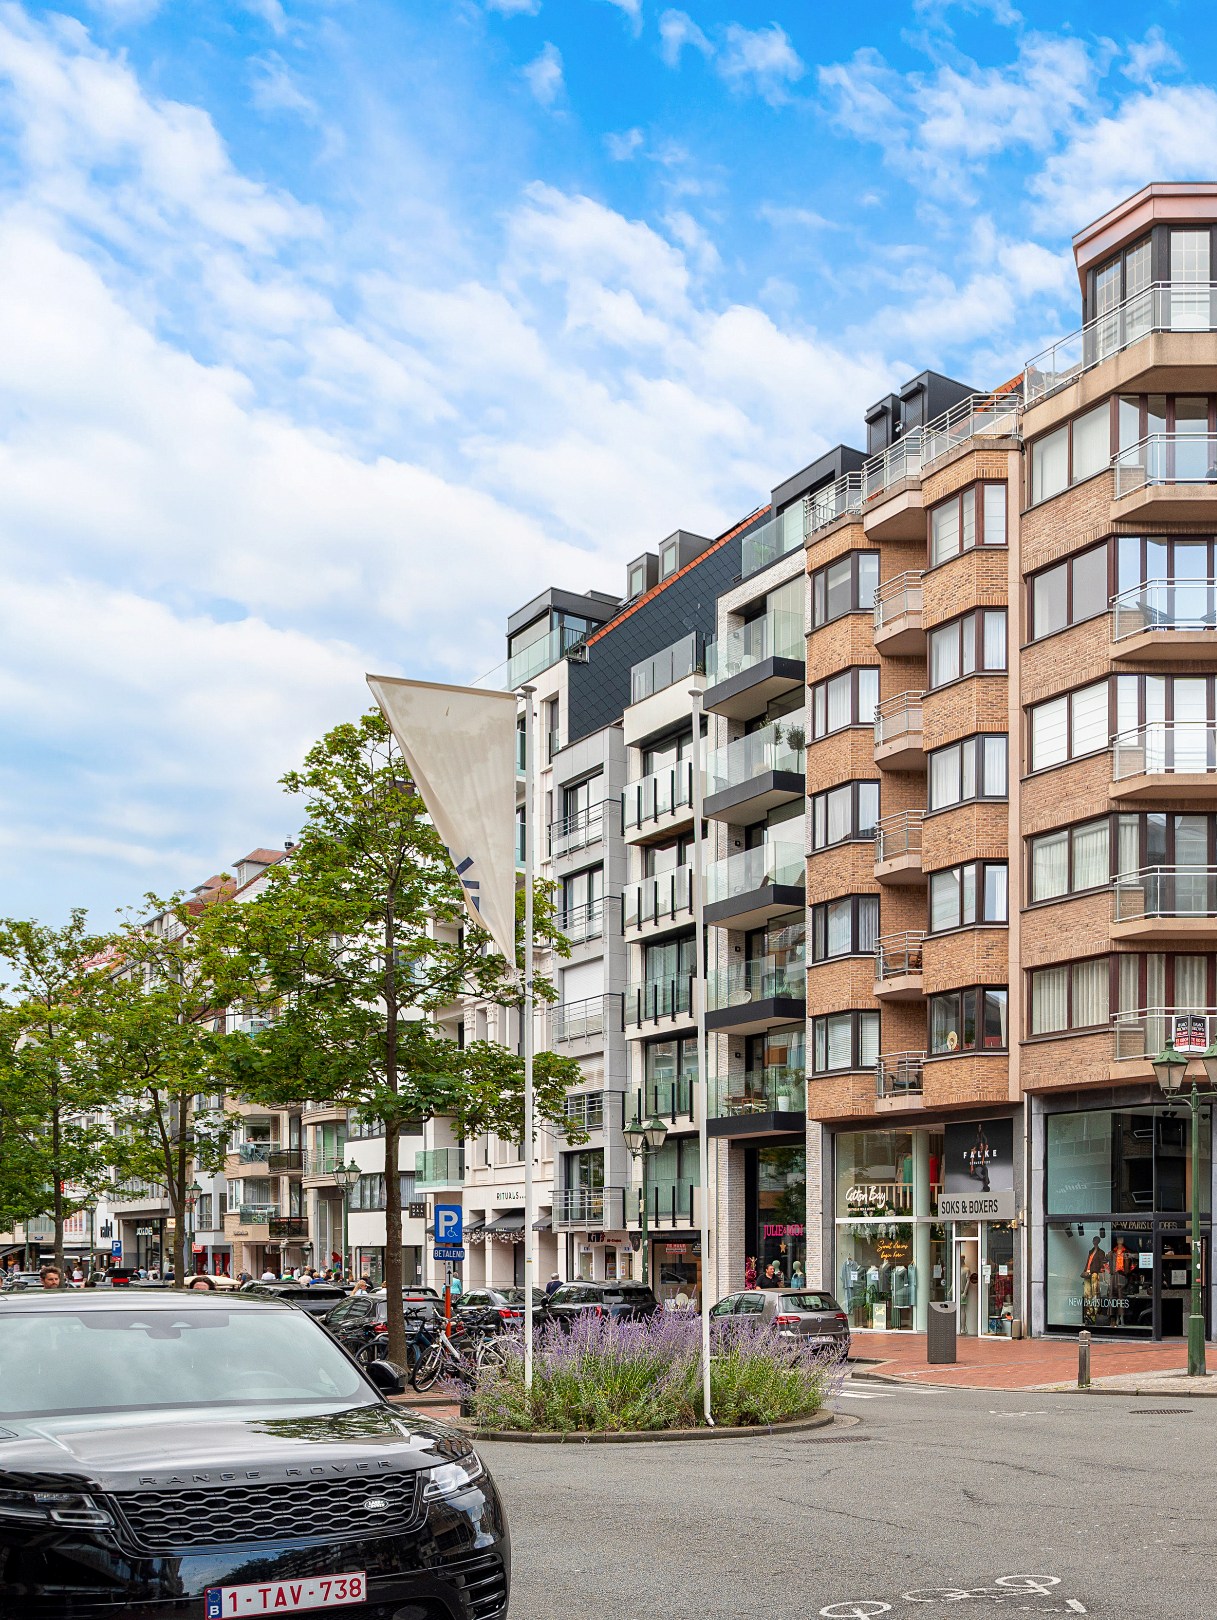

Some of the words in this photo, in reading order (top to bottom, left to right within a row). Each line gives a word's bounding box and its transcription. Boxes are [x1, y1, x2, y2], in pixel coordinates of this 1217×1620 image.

[963, 1149, 998, 1159] FALKE
[869, 1185, 886, 1208] Bay
[942, 1201, 960, 1214] SOKS
[962, 1201, 967, 1213] &
[969, 1199, 998, 1213] BOXERS
[439, 1211, 458, 1237] P
[434, 1250, 464, 1258] BETALEND
[1069, 1298, 1082, 1307] NEW
[1101, 1299, 1130, 1309] LONDRES
[139, 1471, 261, 1486] RANGE
[286, 1460, 393, 1477] ROVER
[228, 1578, 362, 1613] 1-TAV-738
[210, 1605, 220, 1617] B
